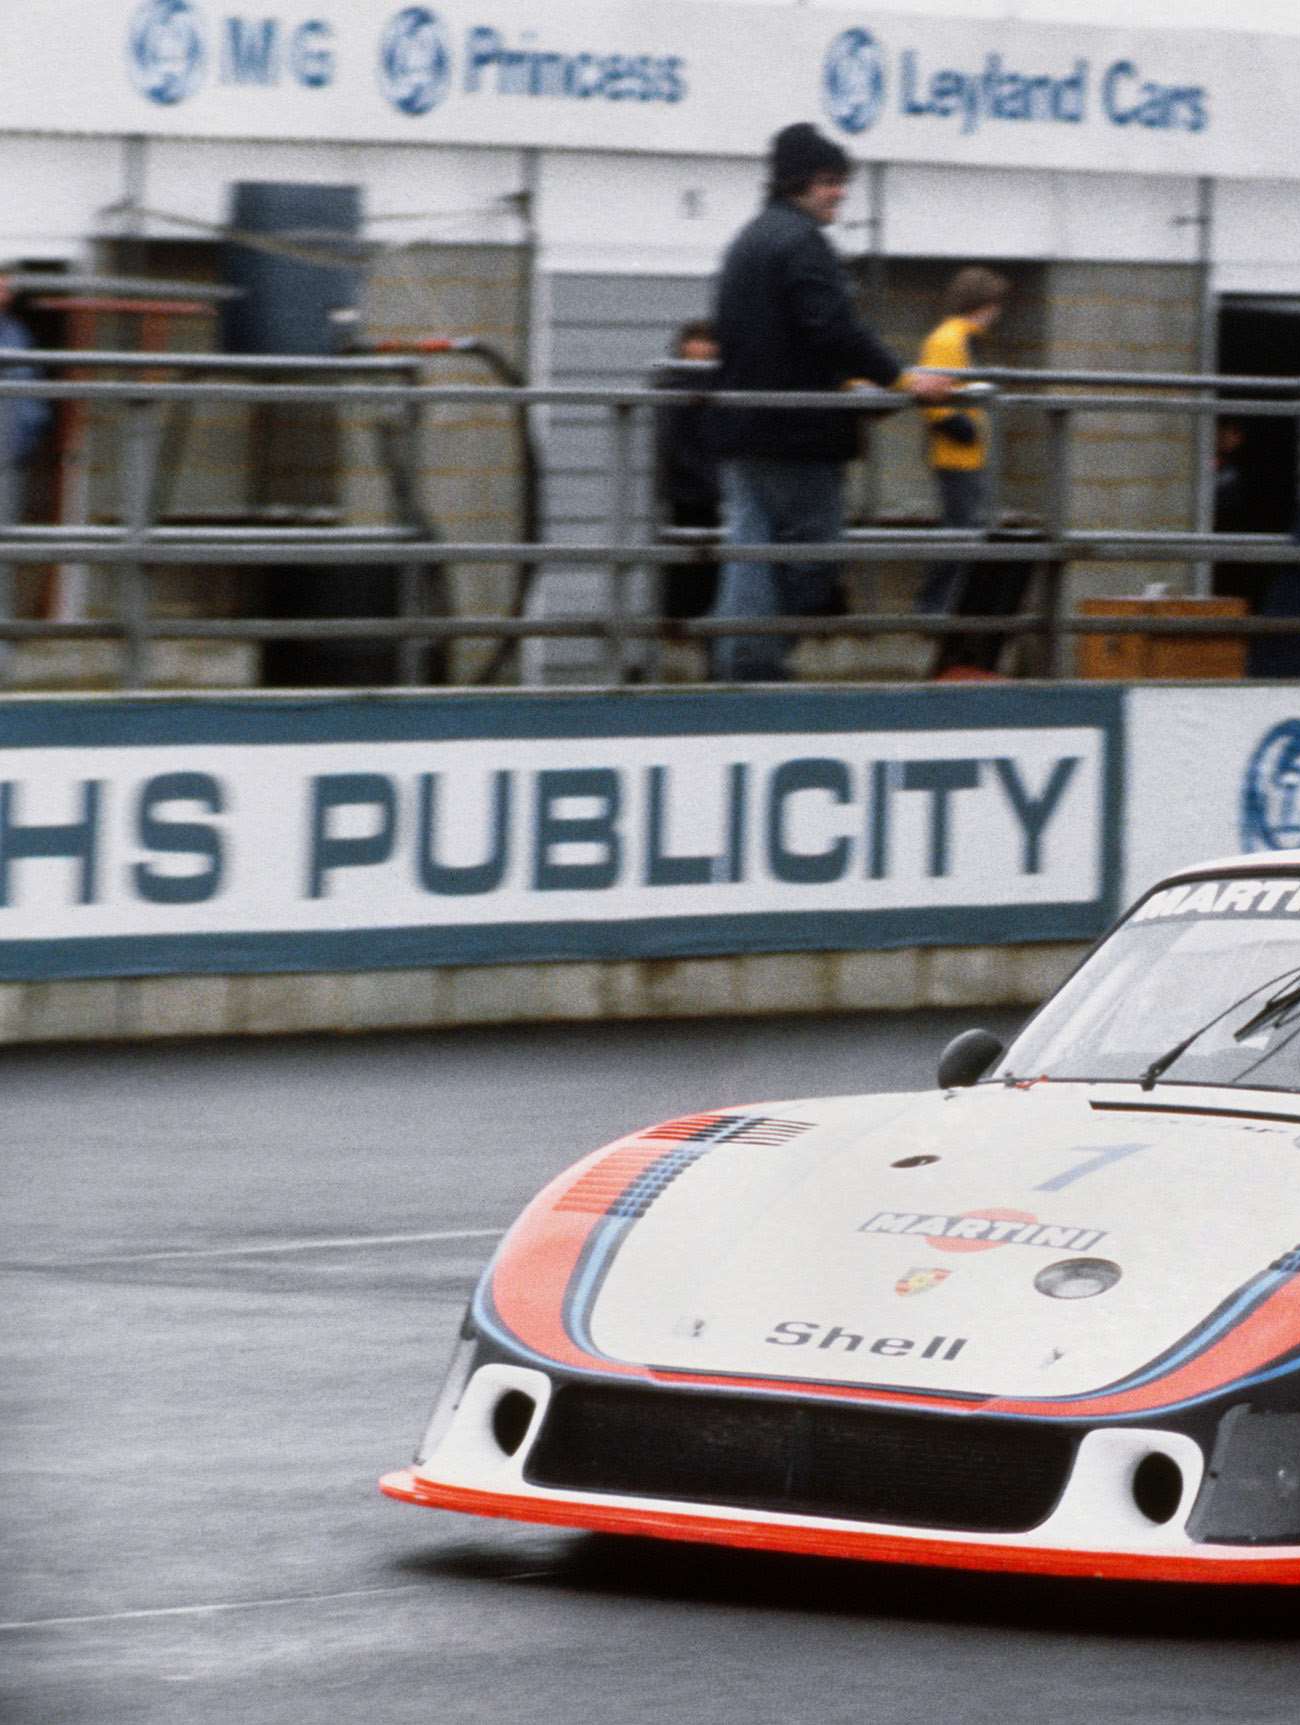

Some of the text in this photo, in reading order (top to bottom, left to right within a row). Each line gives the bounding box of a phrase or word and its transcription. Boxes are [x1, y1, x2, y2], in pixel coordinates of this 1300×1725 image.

[898, 50, 1208, 133] Leyland Cars
[307, 757, 1080, 901] PUBLICITY
[861, 1212, 1104, 1250] MARTINI
[765, 1321, 968, 1361] Shell
